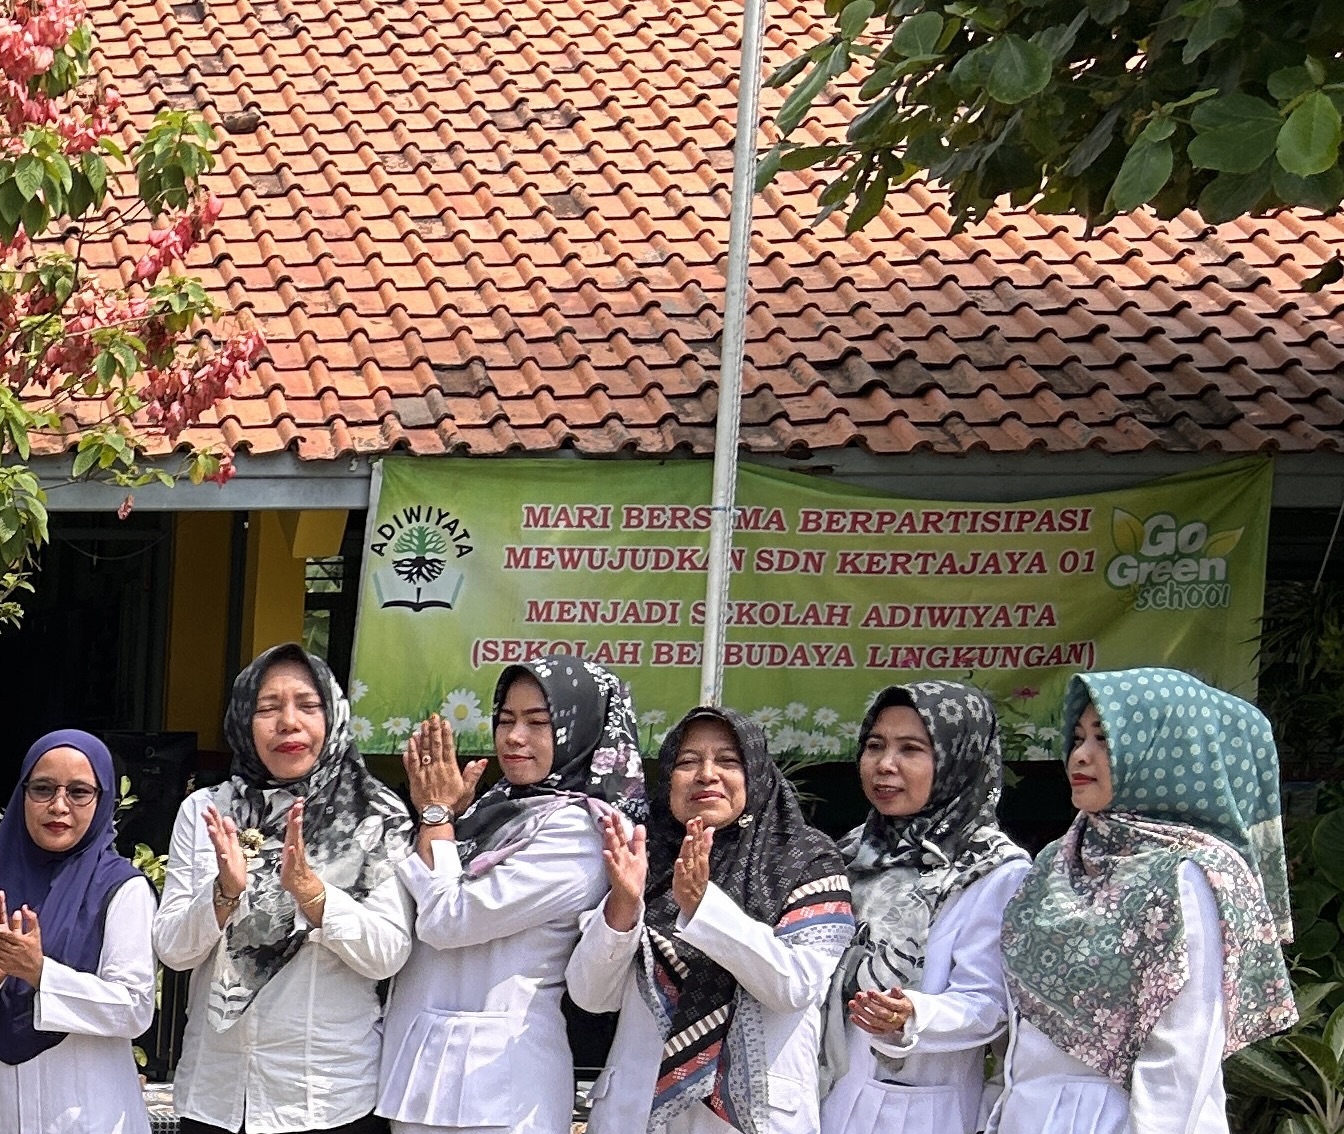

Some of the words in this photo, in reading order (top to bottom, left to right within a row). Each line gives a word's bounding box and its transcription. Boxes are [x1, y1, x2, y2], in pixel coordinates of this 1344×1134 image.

[370, 505, 474, 559] ADIWIYATA
[523, 506, 612, 529] MARI
[623, 506, 786, 532] BERSMA
[798, 509, 1092, 534] BERPARTISIPASI
[1139, 513, 1208, 557] Go
[755, 549, 825, 574] SDN
[836, 551, 1047, 575] KERTAJAYA
[1059, 550, 1095, 573] 01
[1106, 554, 1227, 588] Green
[1135, 580, 1231, 611] school
[526, 600, 681, 625] MENJADI
[692, 602, 852, 627] SKOLAH
[860, 604, 1056, 628] ADIWIYATA
[472, 639, 642, 668] (SEKOLAH
[652, 642, 854, 668] BEBUDAYA
[866, 642, 1095, 670] LINGKUNGAN)
